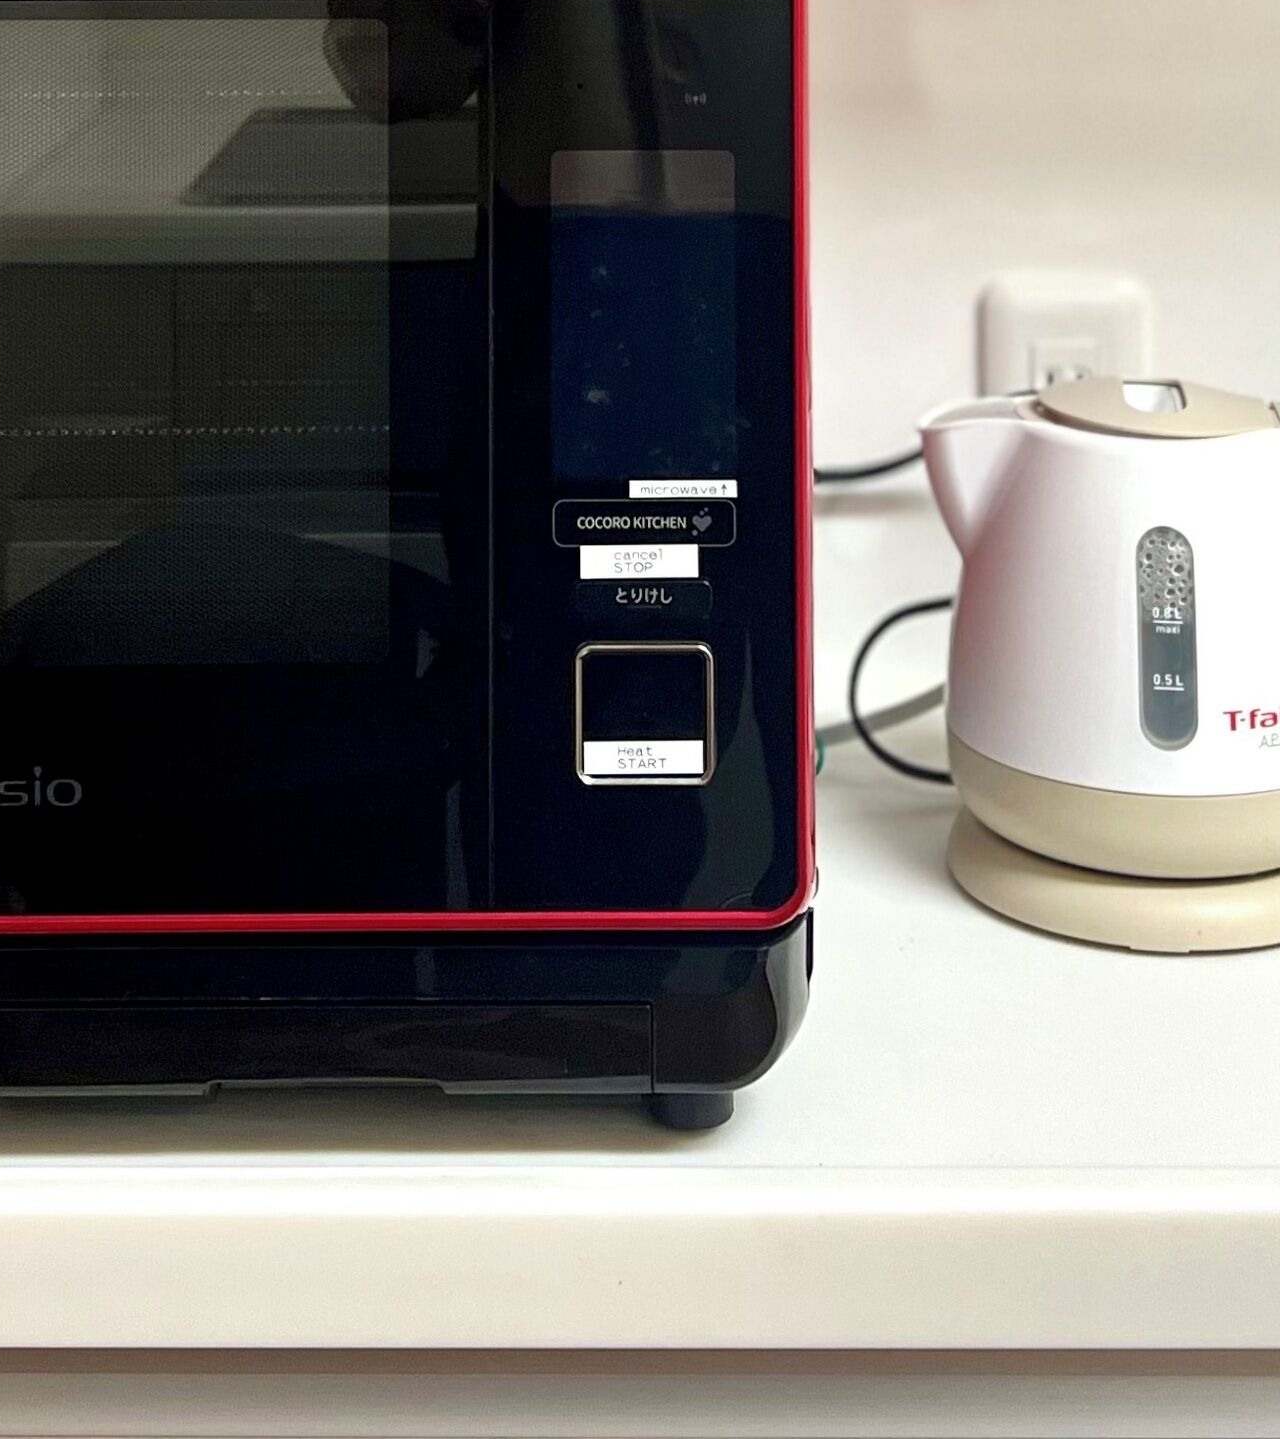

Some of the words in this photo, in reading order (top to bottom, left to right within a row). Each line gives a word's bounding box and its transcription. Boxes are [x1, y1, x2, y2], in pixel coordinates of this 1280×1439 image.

[640, 486, 718, 496] microwave
[576, 516, 631, 530] COCORO
[633, 516, 687, 530] KITCHEN
[614, 548, 663, 561] cancel
[614, 561, 653, 574] STOP
[615, 587, 673, 604] とりけし
[1153, 673, 1173, 686] 0.5
[1175, 674, 1184, 687] L
[617, 746, 653, 757] Heat
[618, 758, 667, 769] START
